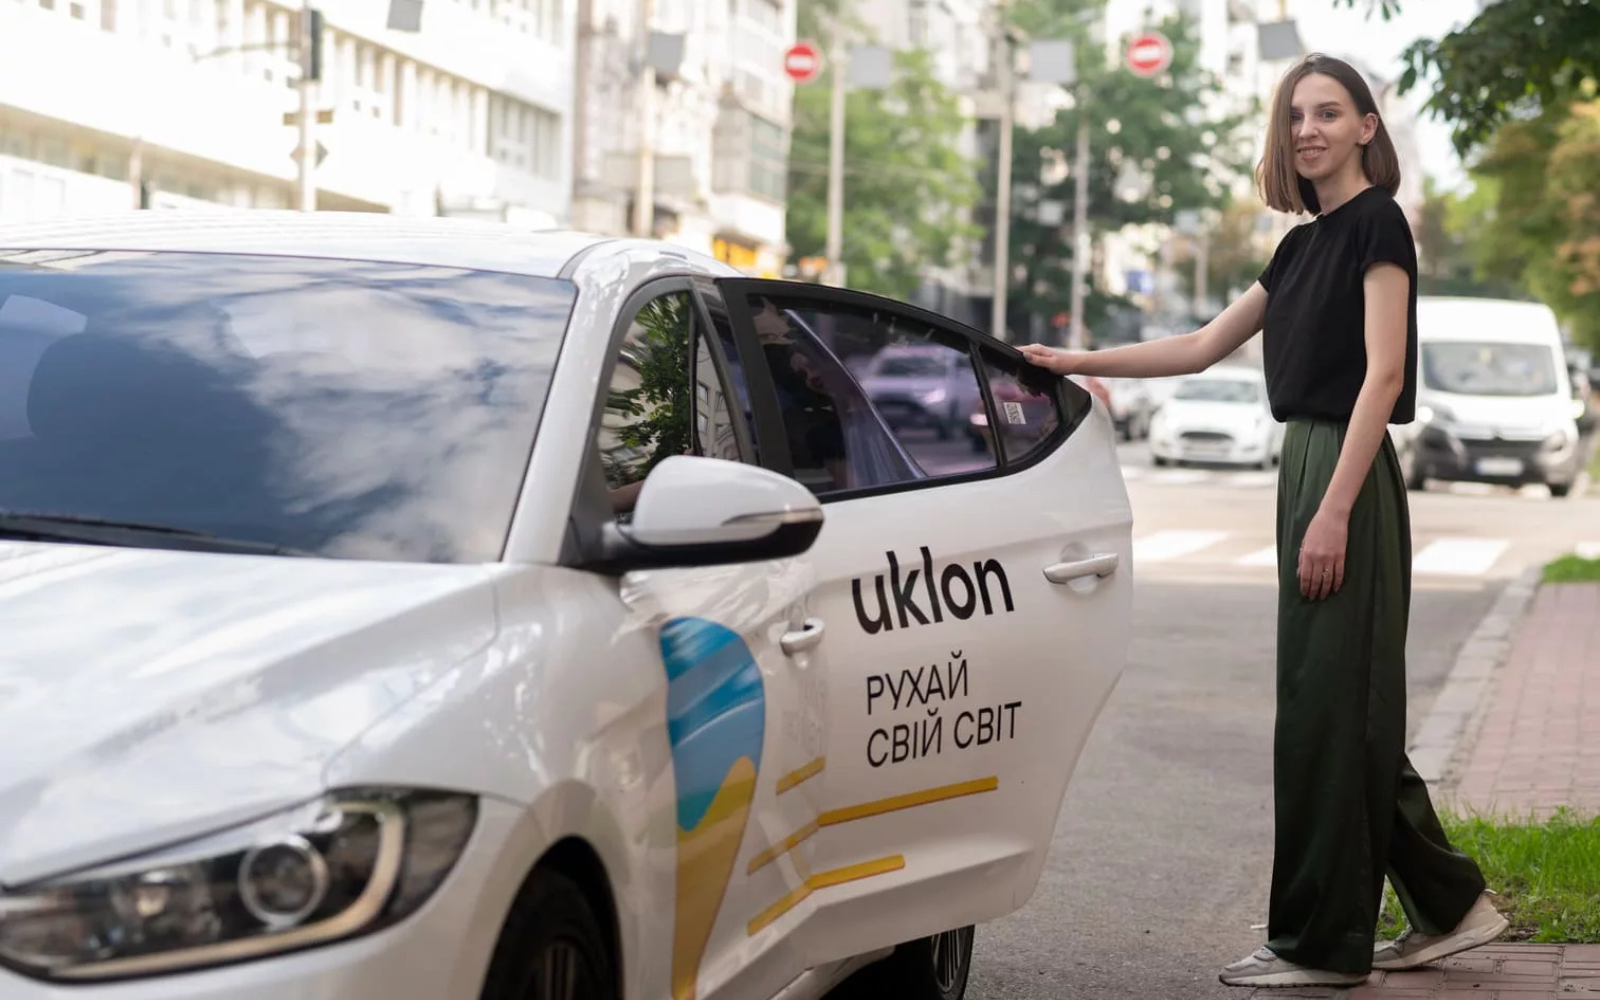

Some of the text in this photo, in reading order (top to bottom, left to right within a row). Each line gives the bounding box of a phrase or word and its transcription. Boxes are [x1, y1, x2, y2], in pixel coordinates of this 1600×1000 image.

[852, 546, 1015, 635] uklon
[866, 649, 969, 716] РУХАЙ
[866, 701, 1023, 769] СВІЙ СВІТ
